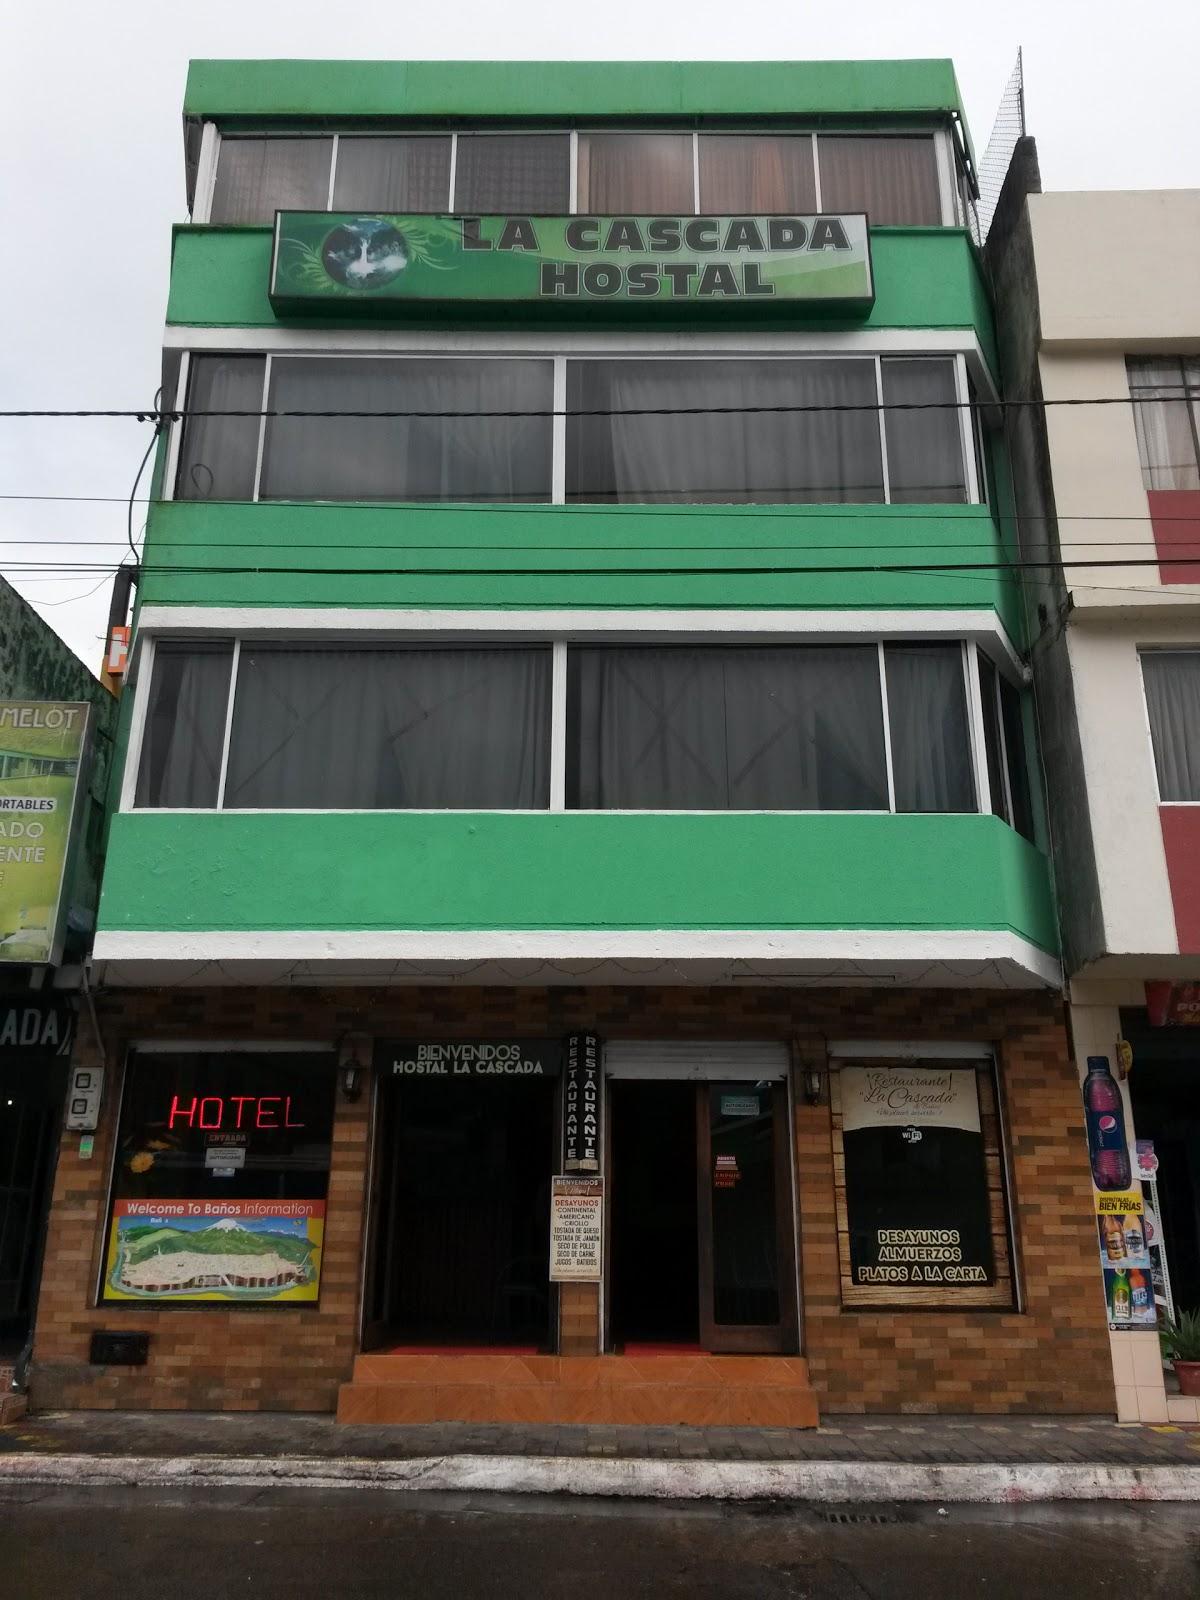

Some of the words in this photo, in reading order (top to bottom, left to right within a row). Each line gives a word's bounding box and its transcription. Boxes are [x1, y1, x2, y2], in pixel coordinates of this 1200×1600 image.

[461, 216, 540, 252] LA
[566, 217, 852, 252] CASCADA
[540, 262, 776, 297] HOSTAL
[0, 798, 54, 811] RTABLES
[417, 1044, 521, 1061] BIENVENIDOS
[392, 1060, 449, 1074] HOSTAL
[453, 1061, 471, 1074] LA
[475, 1061, 544, 1074] CASCADA
[567, 1035, 578, 1159] RESTAURANTE
[583, 1035, 597, 1159] RESTAURANTE
[168, 1095, 305, 1129] HOTEL
[127, 1203, 185, 1215] Welcome
[188, 1203, 201, 1214] To
[204, 1202, 241, 1215] Baños
[244, 1202, 314, 1215] Information
[555, 1199, 599, 1207] DESAYUNOS
[1099, 1202, 1117, 1211] BIEN
[1119, 1200, 1142, 1211] FRÍAS
[553, 1234, 574, 1242] TOSTADA
[574, 1234, 581, 1242] DE
[877, 1229, 961, 1245] DESAYUNOS
[878, 1246, 962, 1262] ALMUERZOS
[858, 1266, 909, 1282] PLATOS
[910, 1265, 923, 1281] A
[924, 1265, 944, 1281] LA
[943, 1265, 988, 1282] CARTA
